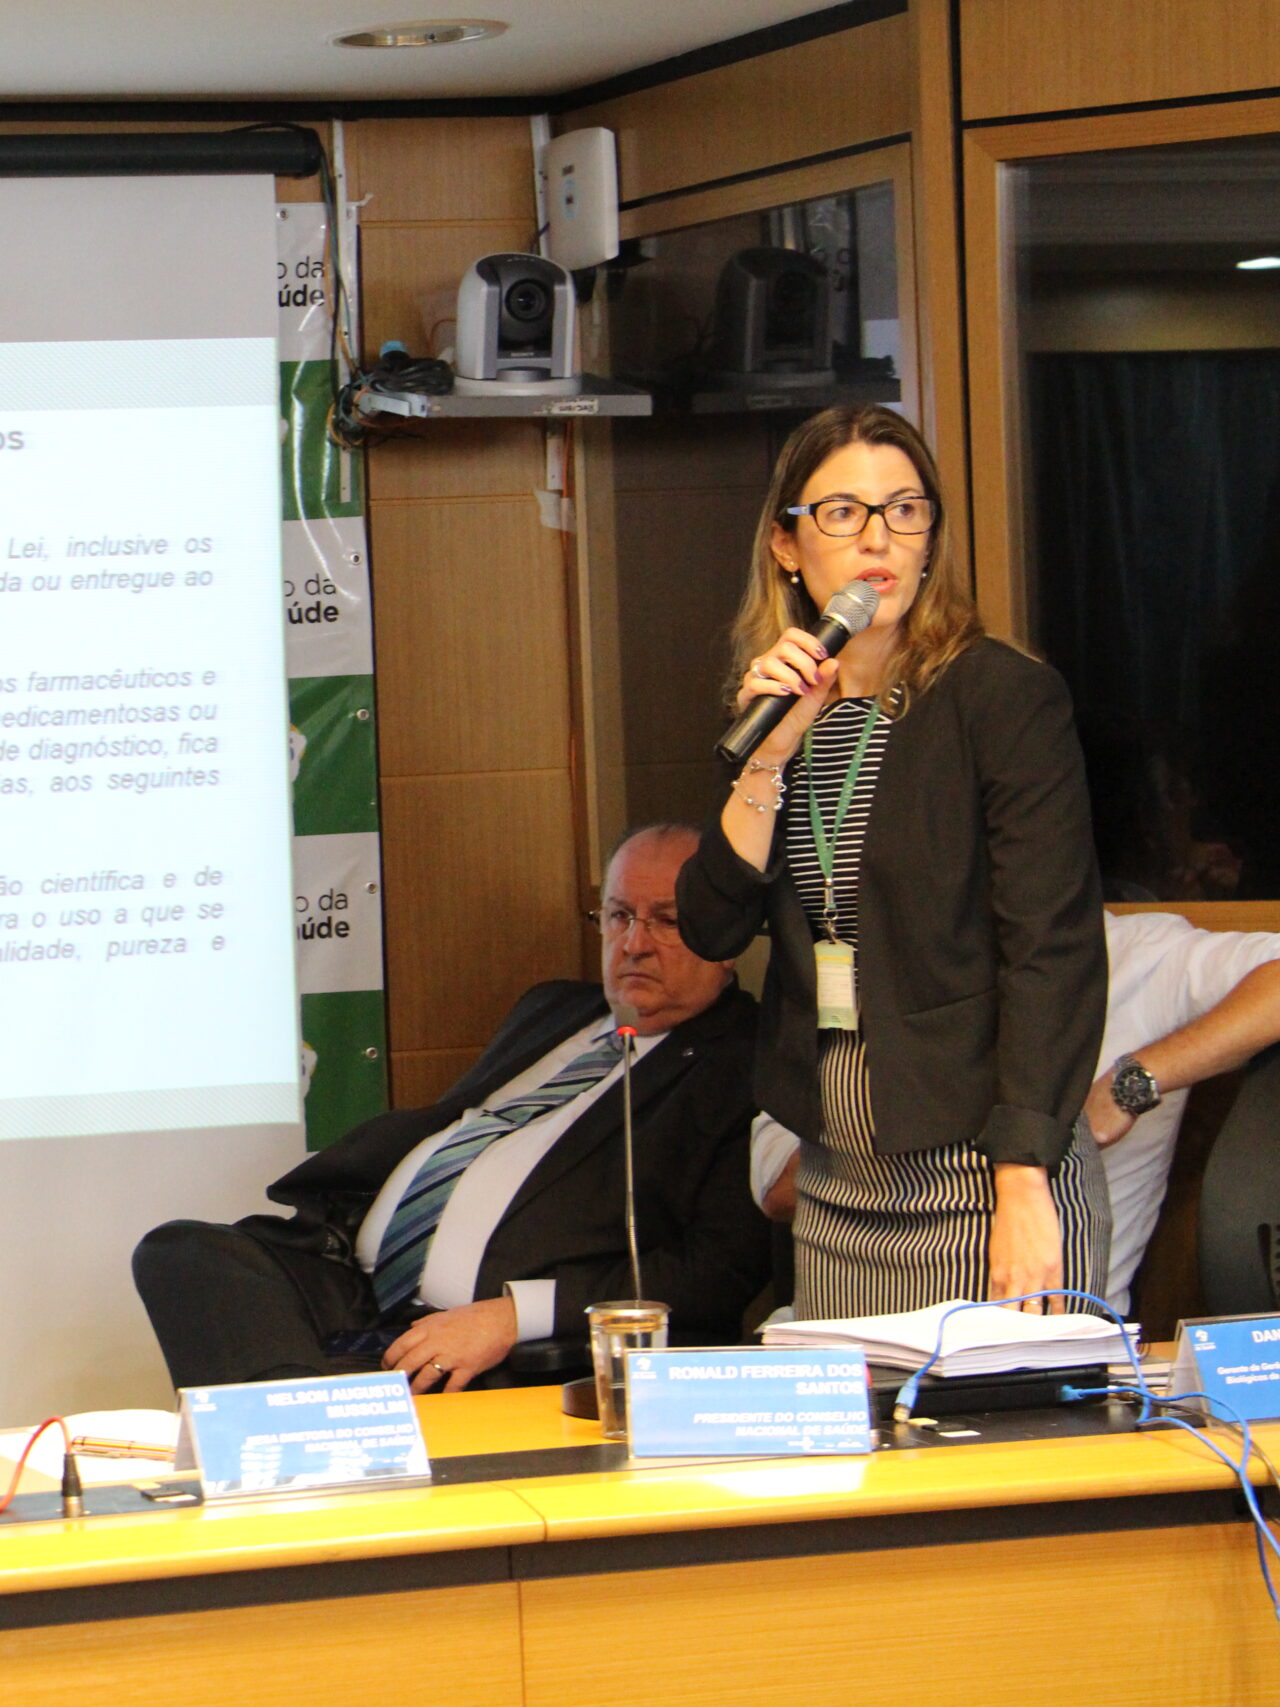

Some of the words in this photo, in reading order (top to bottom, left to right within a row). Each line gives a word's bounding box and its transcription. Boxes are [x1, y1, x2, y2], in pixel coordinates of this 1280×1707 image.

[295, 256, 324, 278] da
[7, 537, 50, 562] Lei,
[66, 534, 171, 558] inclusive
[183, 537, 214, 554] os
[30, 574, 62, 592] ou
[69, 569, 177, 595] entregue
[183, 570, 214, 587] ao
[305, 573, 336, 595] da
[27, 667, 194, 693] farmacêuticos
[201, 670, 218, 687] e
[188, 704, 219, 722] ou
[27, 735, 169, 766] diagnóstico,
[178, 732, 220, 755] fica
[49, 774, 94, 794] aos
[106, 766, 221, 796] seguintes
[39, 869, 146, 896] científica
[162, 872, 178, 890] e
[193, 864, 225, 888] de
[318, 888, 348, 911] da
[31, 911, 48, 929] o
[59, 908, 103, 927] uso
[113, 907, 129, 925] a
[140, 904, 187, 928] que
[197, 902, 226, 921] se
[297, 916, 350, 940] úde
[105, 936, 189, 963] pureza
[210, 934, 227, 952] e
[669, 1366, 738, 1380] RONALD
[741, 1364, 824, 1379] FERREIRA
[827, 1363, 863, 1377] DOS
[266, 1387, 329, 1406] NELSON
[331, 1383, 404, 1401] AUGUSTO
[795, 1381, 864, 1395] SANTOS
[693, 1412, 773, 1424] PRESIDENTE
[796, 1411, 867, 1423] CONSELHO
[736, 1426, 800, 1437] NACIONAL
